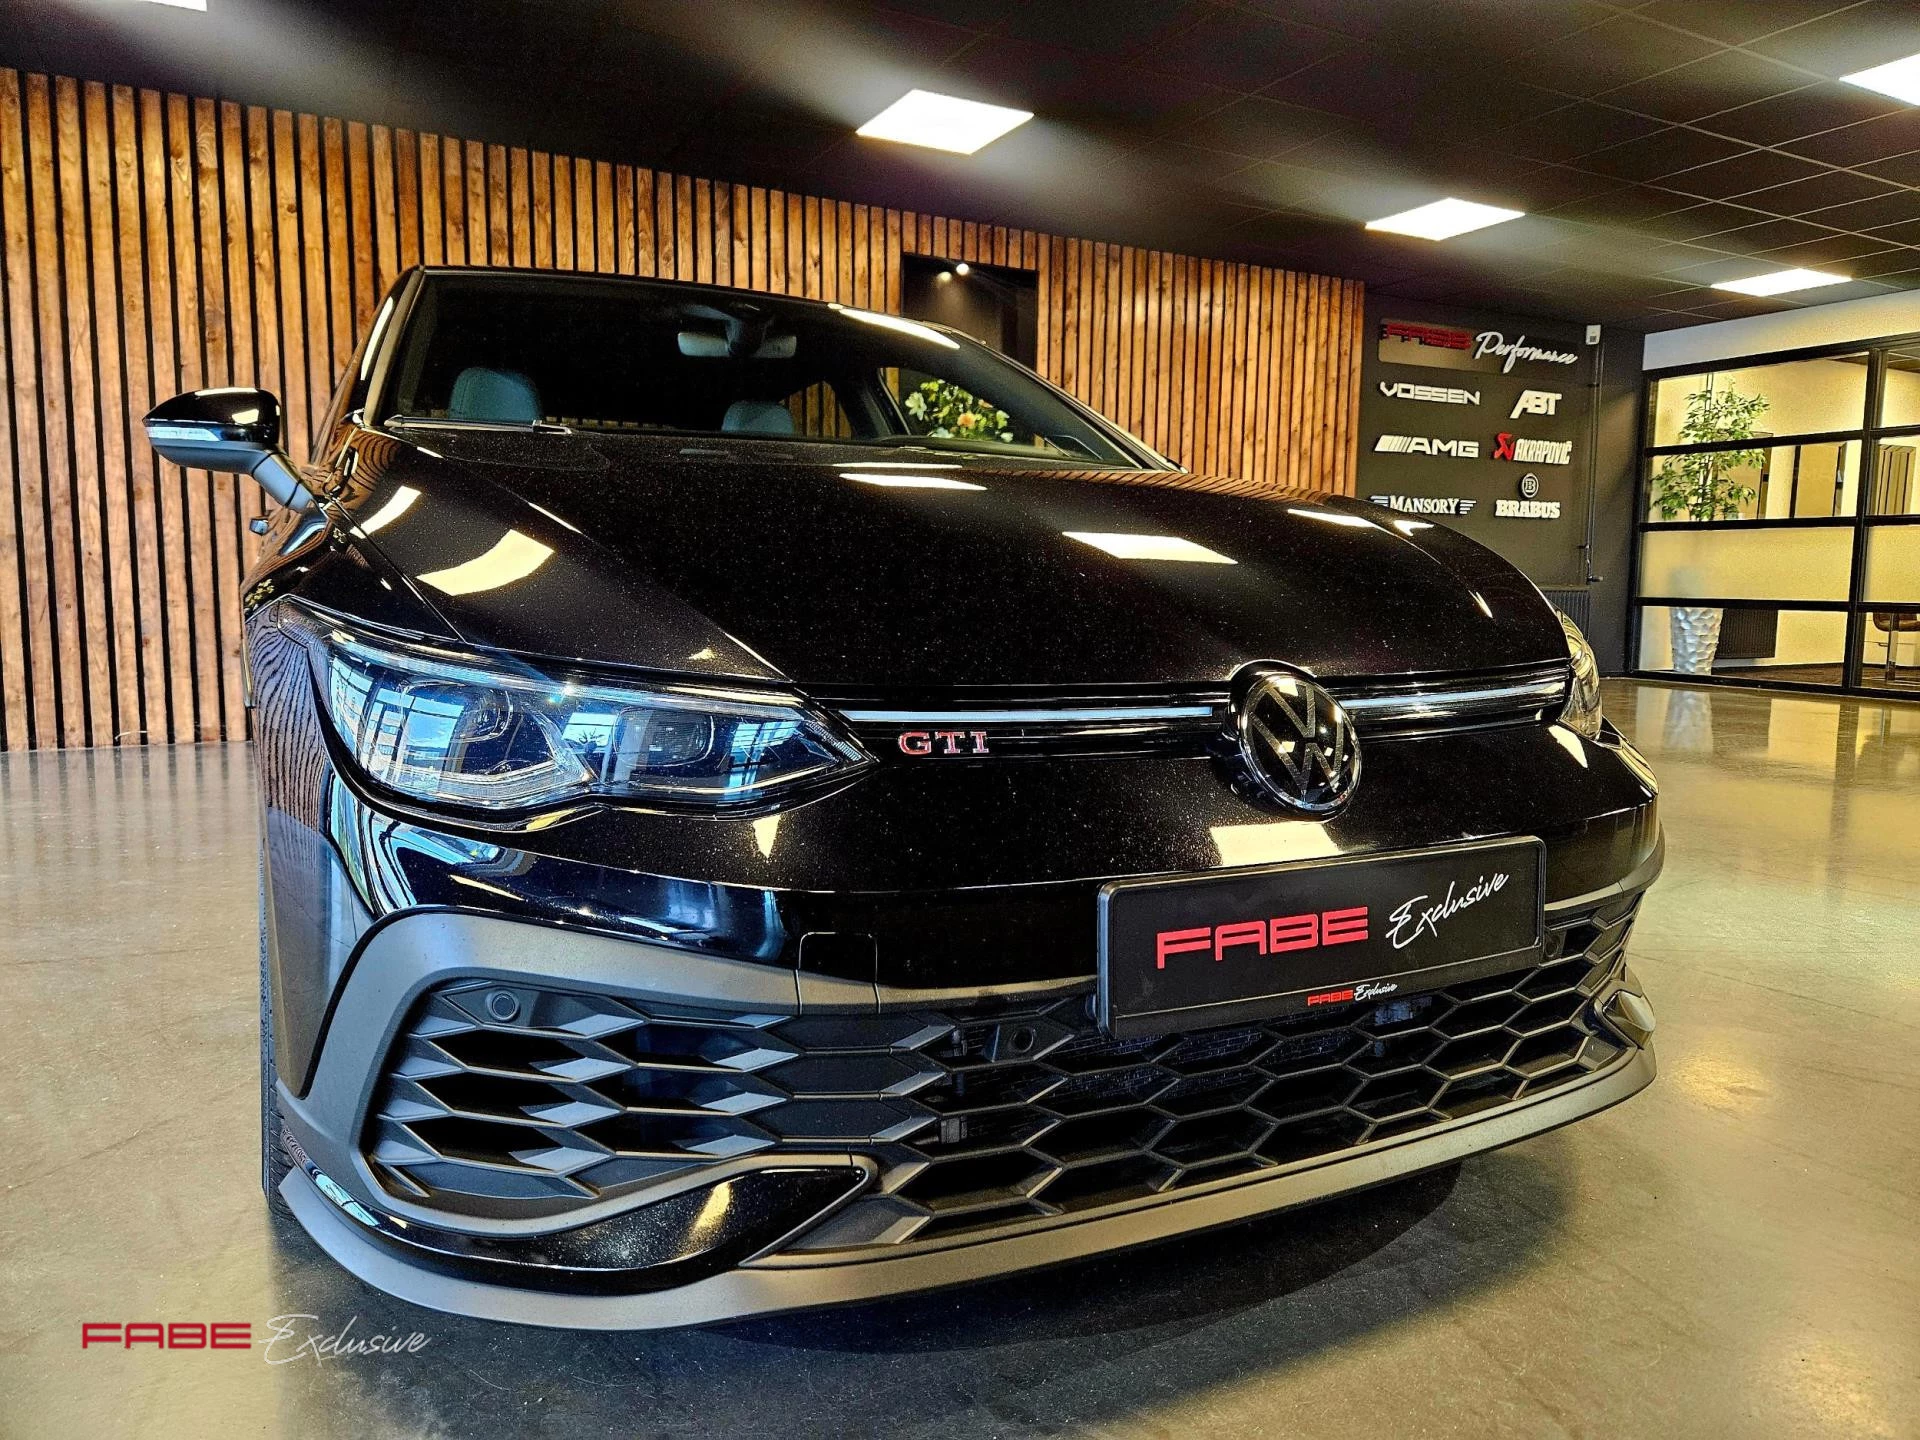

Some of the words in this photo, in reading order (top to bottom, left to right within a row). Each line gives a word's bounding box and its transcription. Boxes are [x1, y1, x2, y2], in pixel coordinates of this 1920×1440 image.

[1473, 331, 1578, 374] Performance
[1380, 381, 1480, 405] VOSSEN
[1509, 389, 1562, 419] ABT
[1389, 495, 1459, 514] MANSORY
[1495, 499, 1560, 518] BRABUS
[898, 731, 990, 756] GTI
[1156, 906, 1369, 969] FABE
[1385, 871, 1509, 949] Exclusive
[1307, 989, 1353, 1006] FABE
[1354, 982, 1398, 1001] Exclusive
